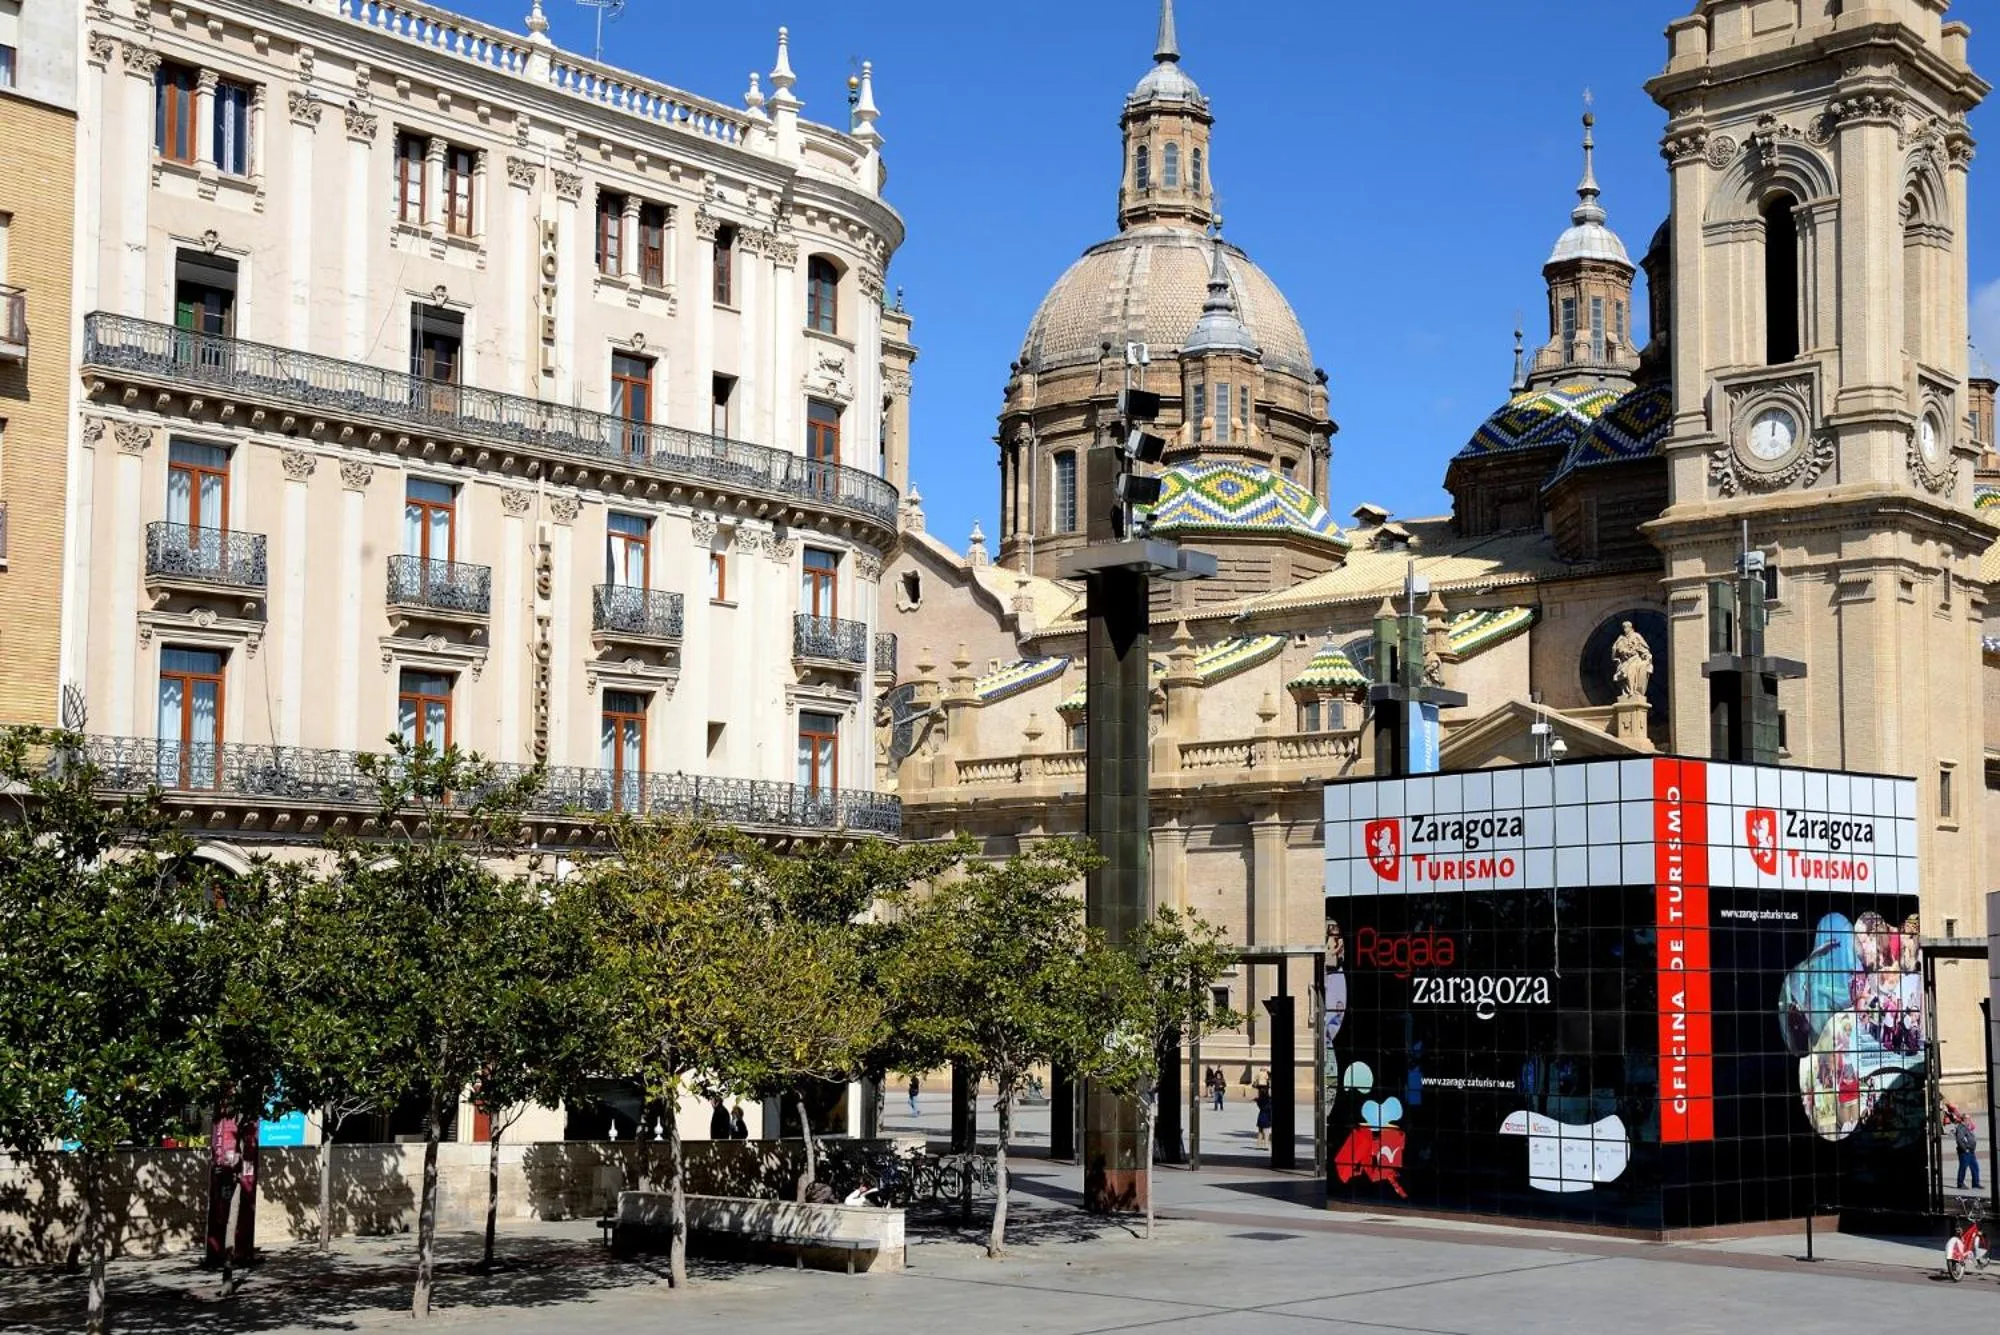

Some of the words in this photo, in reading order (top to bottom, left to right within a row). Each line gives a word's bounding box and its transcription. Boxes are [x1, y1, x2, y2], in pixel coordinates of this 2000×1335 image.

[1411, 815, 1523, 849] Zaragoza
[1786, 810, 1872, 850] Zaragoza
[1411, 854, 1515, 881] TURISMO
[1667, 786, 1683, 922] TURISMO
[1787, 850, 1868, 881] TURISMO
[1356, 926, 1455, 978] Regala
[1670, 940, 1684, 970] DE
[1412, 975, 1551, 1020] zaragoza
[1671, 991, 1687, 1114] OFICINA
